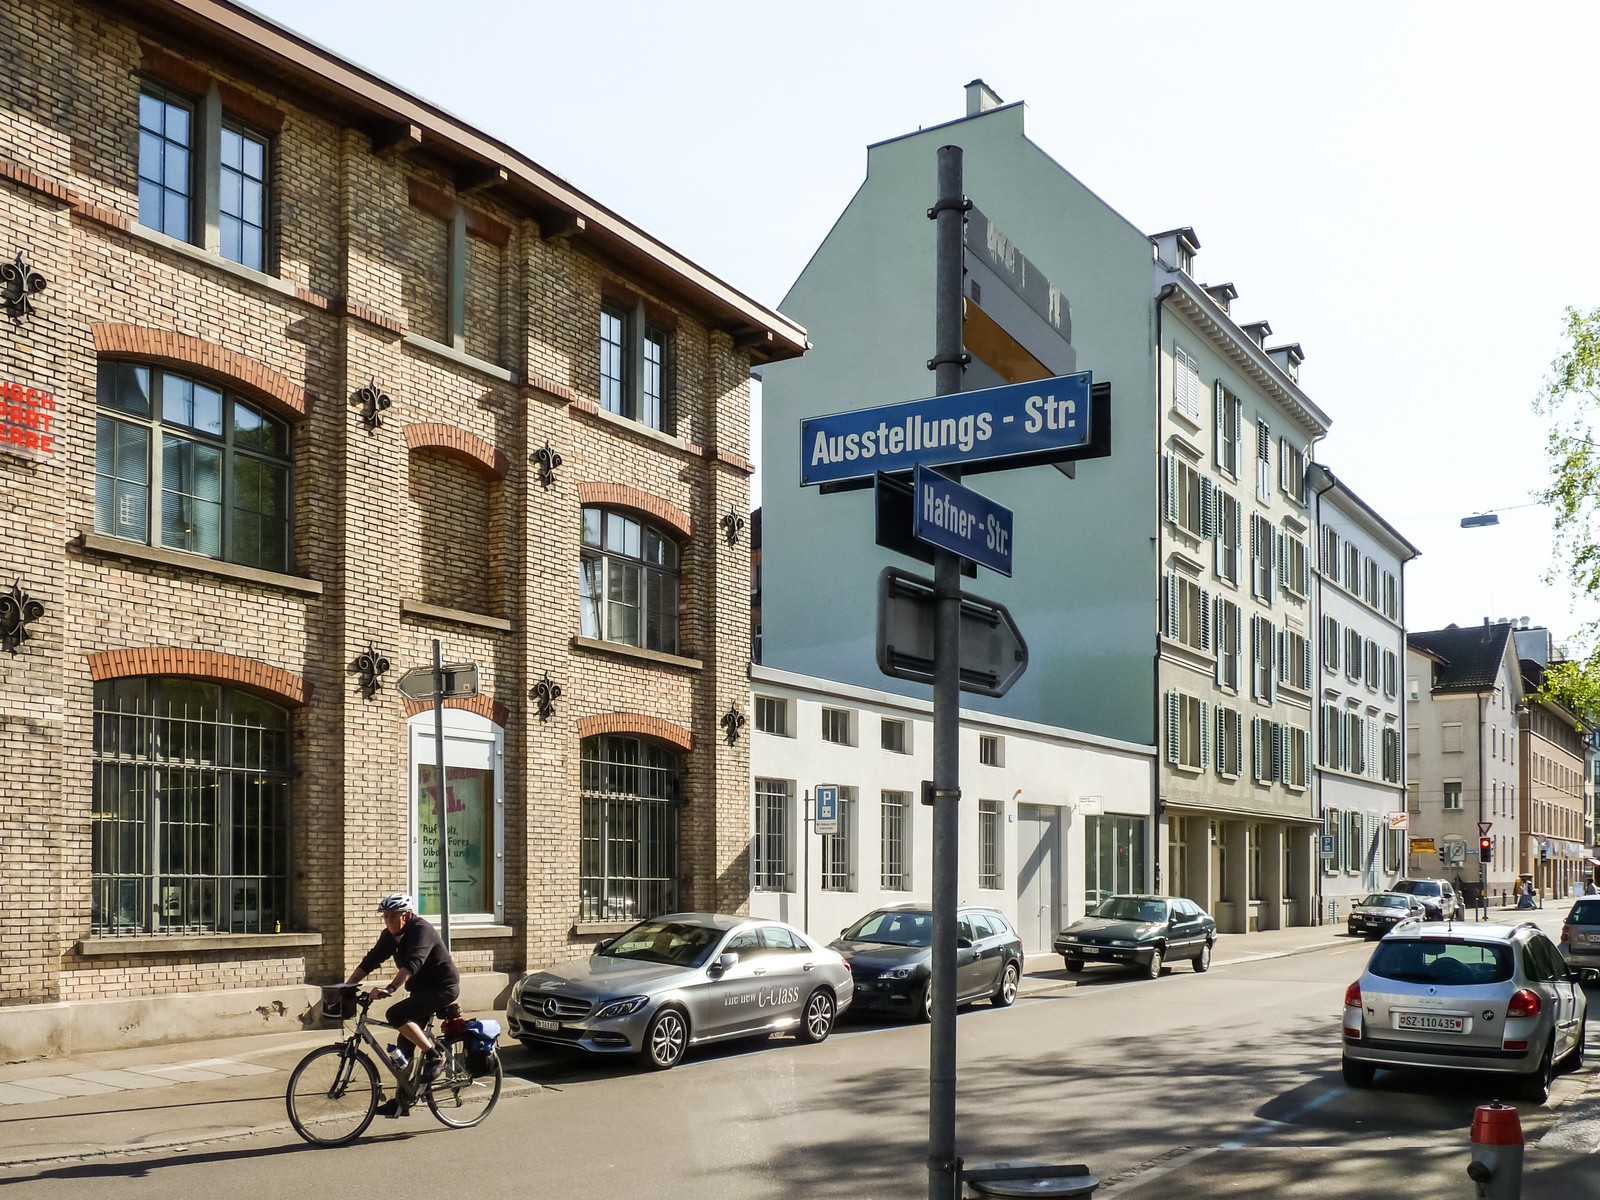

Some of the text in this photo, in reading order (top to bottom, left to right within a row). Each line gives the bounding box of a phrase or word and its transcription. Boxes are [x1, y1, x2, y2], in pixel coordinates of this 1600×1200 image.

[811, 412, 993, 466] Ausstellungs
[1024, 395, 1076, 434] Str.
[823, 791, 831, 806] P
[723, 985, 799, 1008] The new C-Class
